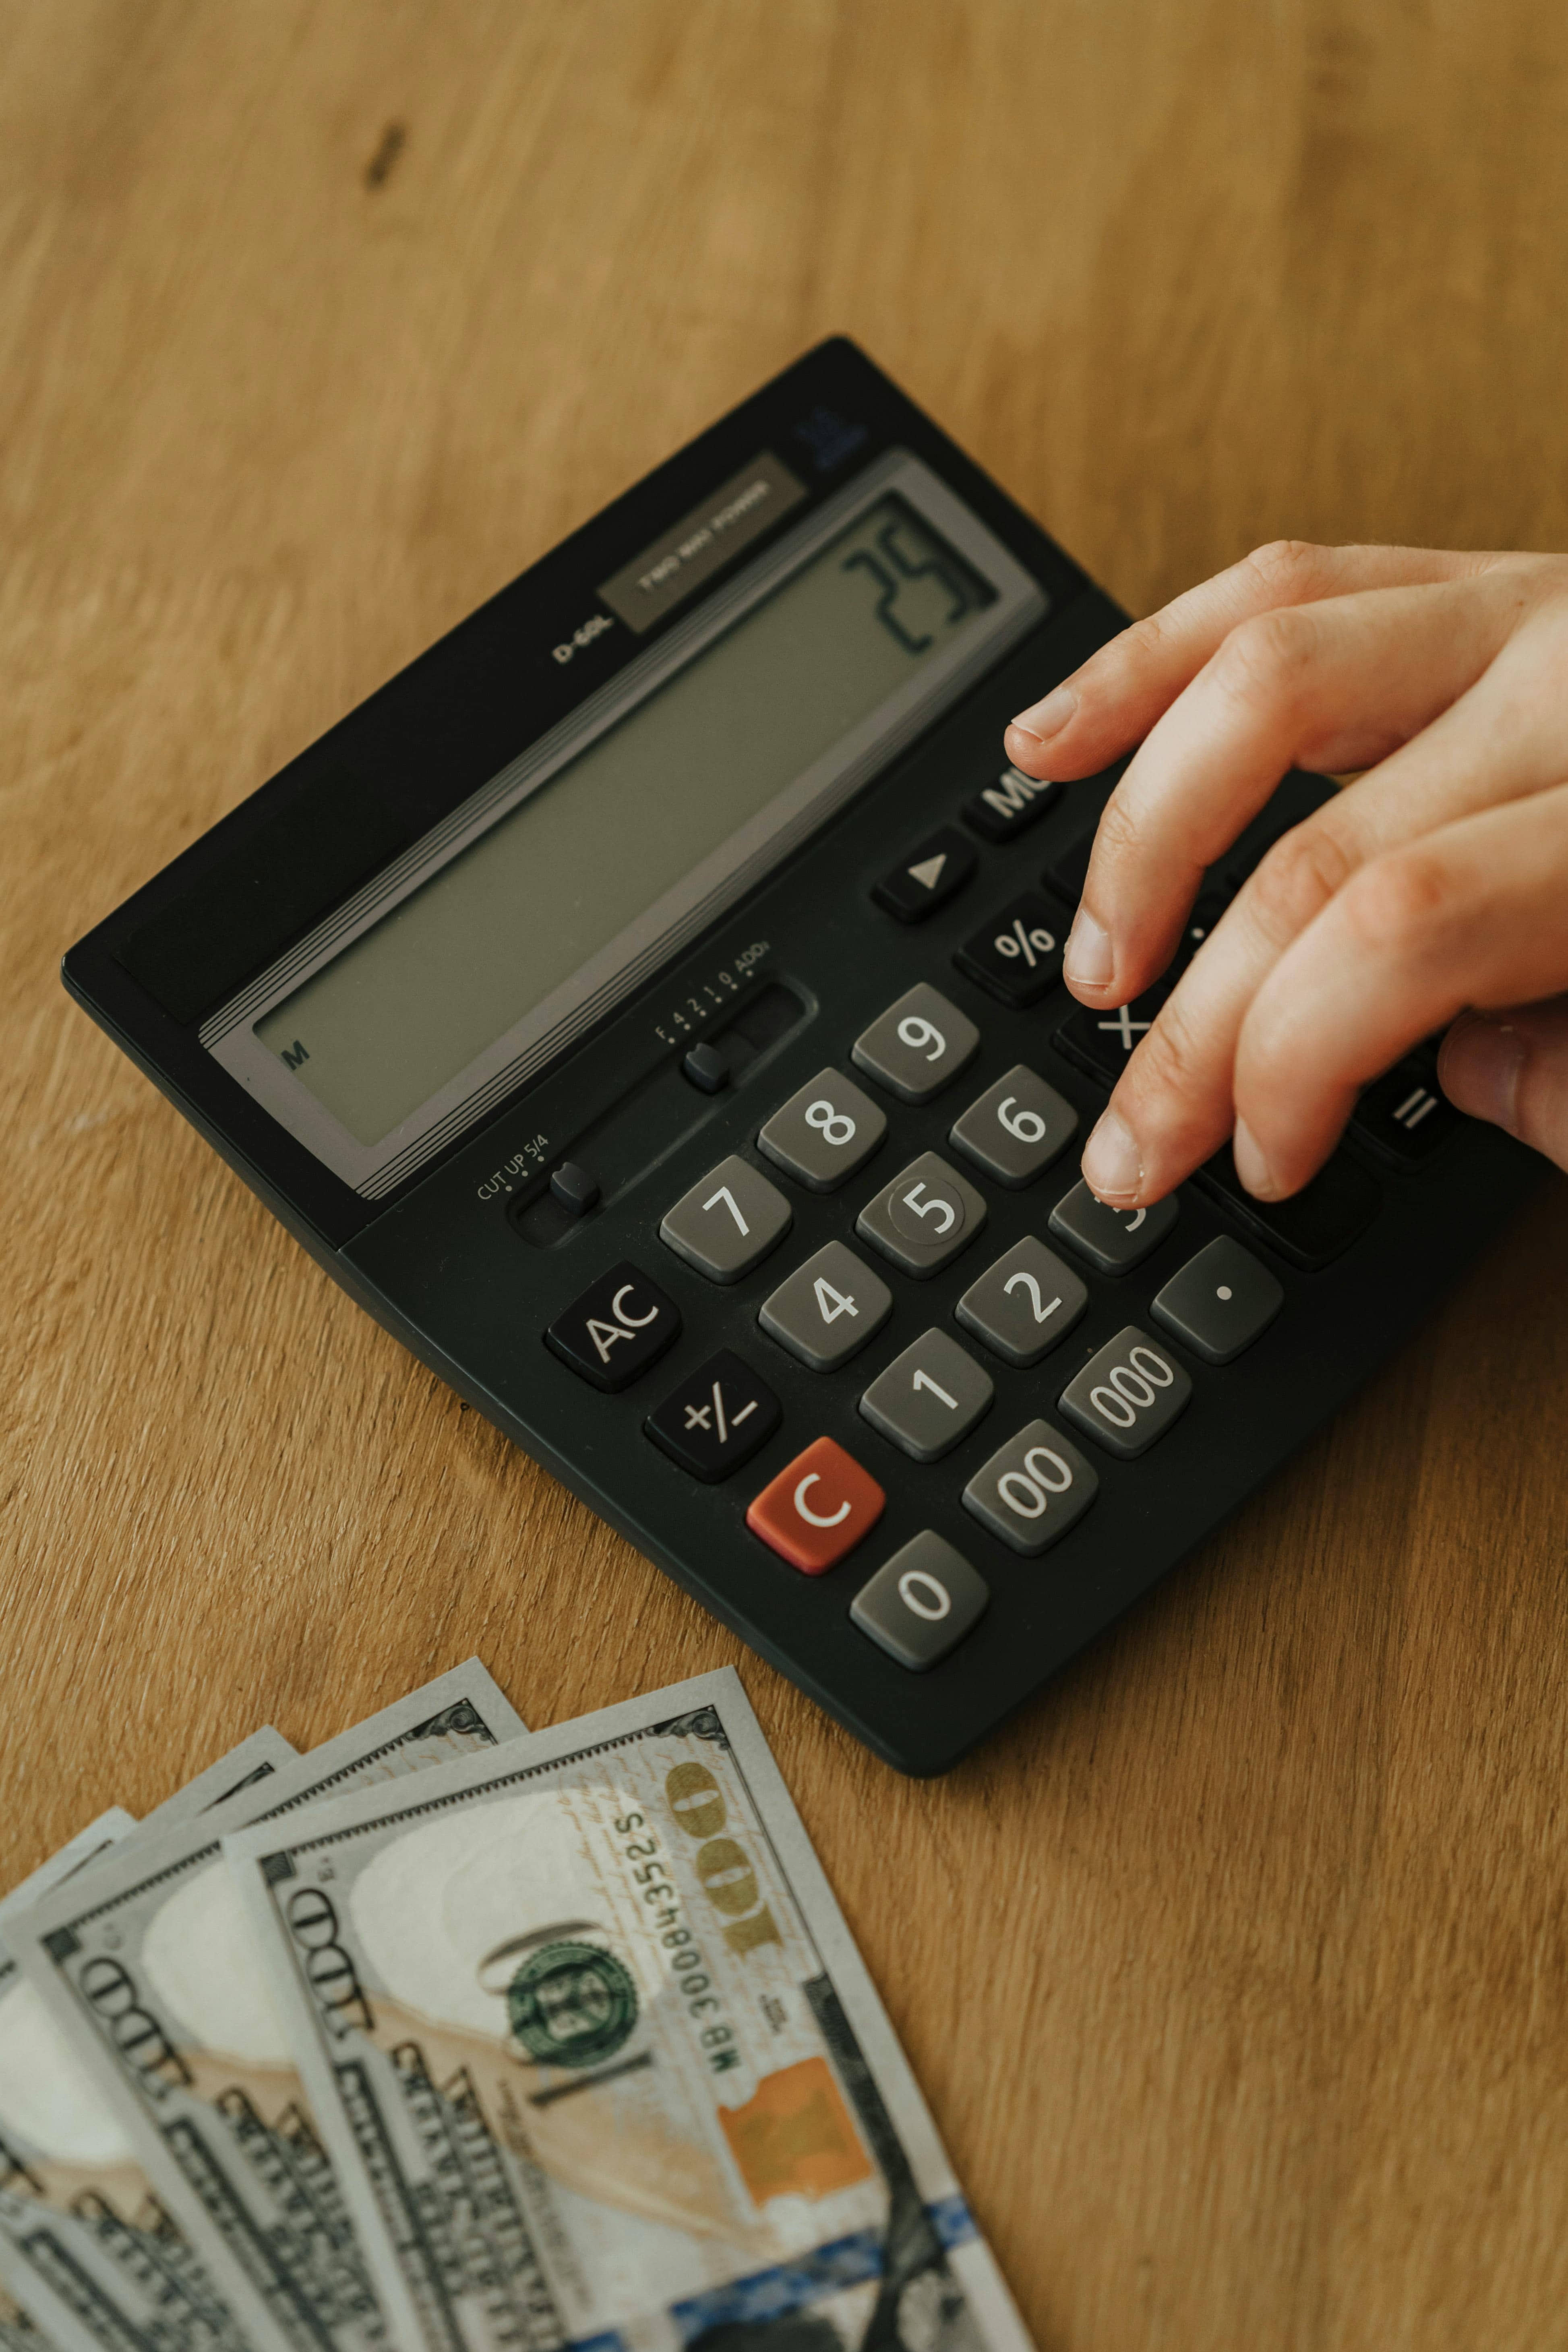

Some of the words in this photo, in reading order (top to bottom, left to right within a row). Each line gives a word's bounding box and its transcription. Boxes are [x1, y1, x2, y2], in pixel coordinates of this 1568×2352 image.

[842, 523, 969, 656] 25
[673, 1012, 685, 1024] 4
[687, 998, 701, 1012] 2
[718, 971, 732, 985] 0
[281, 1040, 310, 1071] M
[898, 1016, 945, 1061] 9
[805, 1100, 856, 1145] 8
[997, 1096, 1046, 1143] 6
[478, 1171, 506, 1200] CUT
[504, 1154, 524, 1174] UP
[523, 1134, 549, 1157] 5/4
[702, 1186, 750, 1236] 7
[902, 1182, 955, 1234] 5
[585, 1284, 659, 1363] AC
[813, 1277, 859, 1324] 4
[1003, 1272, 1062, 1324] 2
[913, 1369, 958, 1409] 1
[1090, 1346, 1174, 1428] 000
[794, 1473, 851, 1527] C
[997, 1447, 1072, 1518] 00
[898, 1571, 950, 1620] 0
[665, 1762, 784, 1964] 100
[287, 1889, 375, 2040] 100
